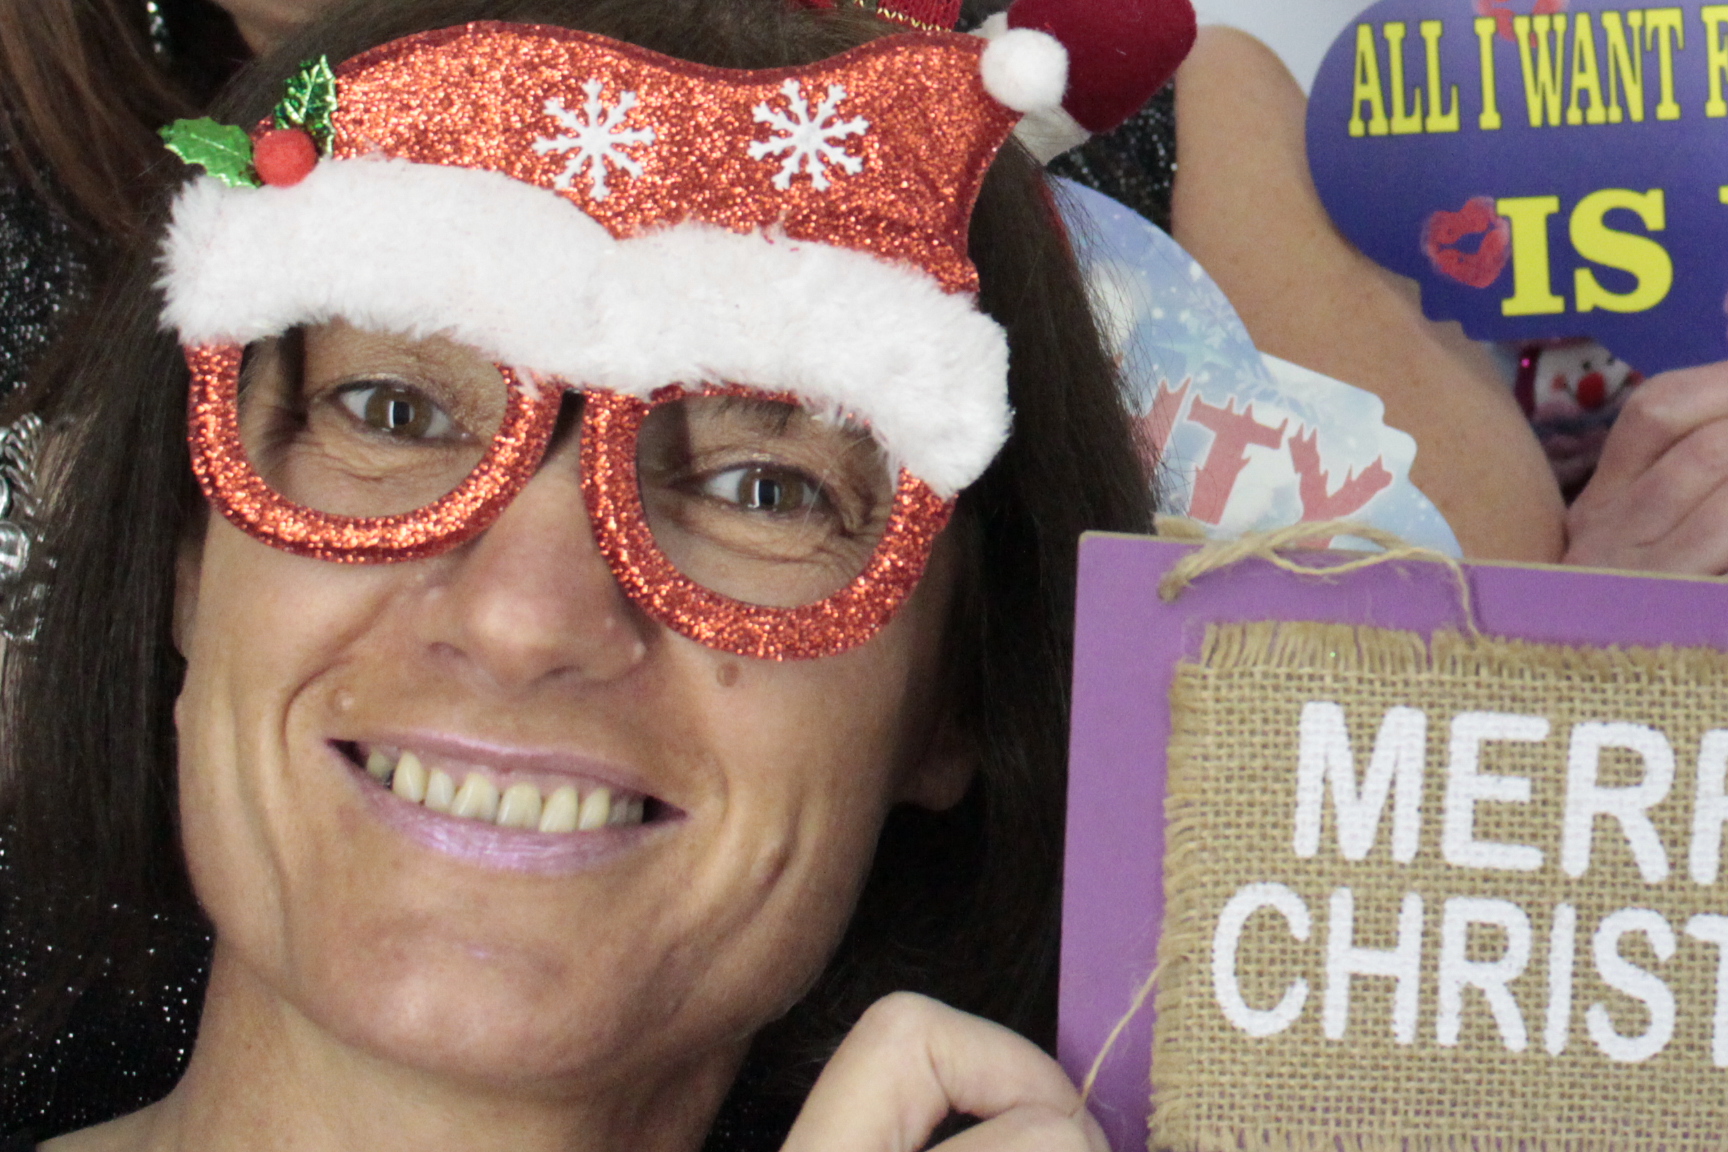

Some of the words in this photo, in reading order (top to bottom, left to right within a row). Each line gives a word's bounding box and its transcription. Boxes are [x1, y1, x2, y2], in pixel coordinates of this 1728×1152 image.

[1347, 19, 1461, 138] ALL
[1473, 15, 1502, 132] I
[1511, 5, 1686, 129] WANT
[1495, 187, 1674, 317] IS
